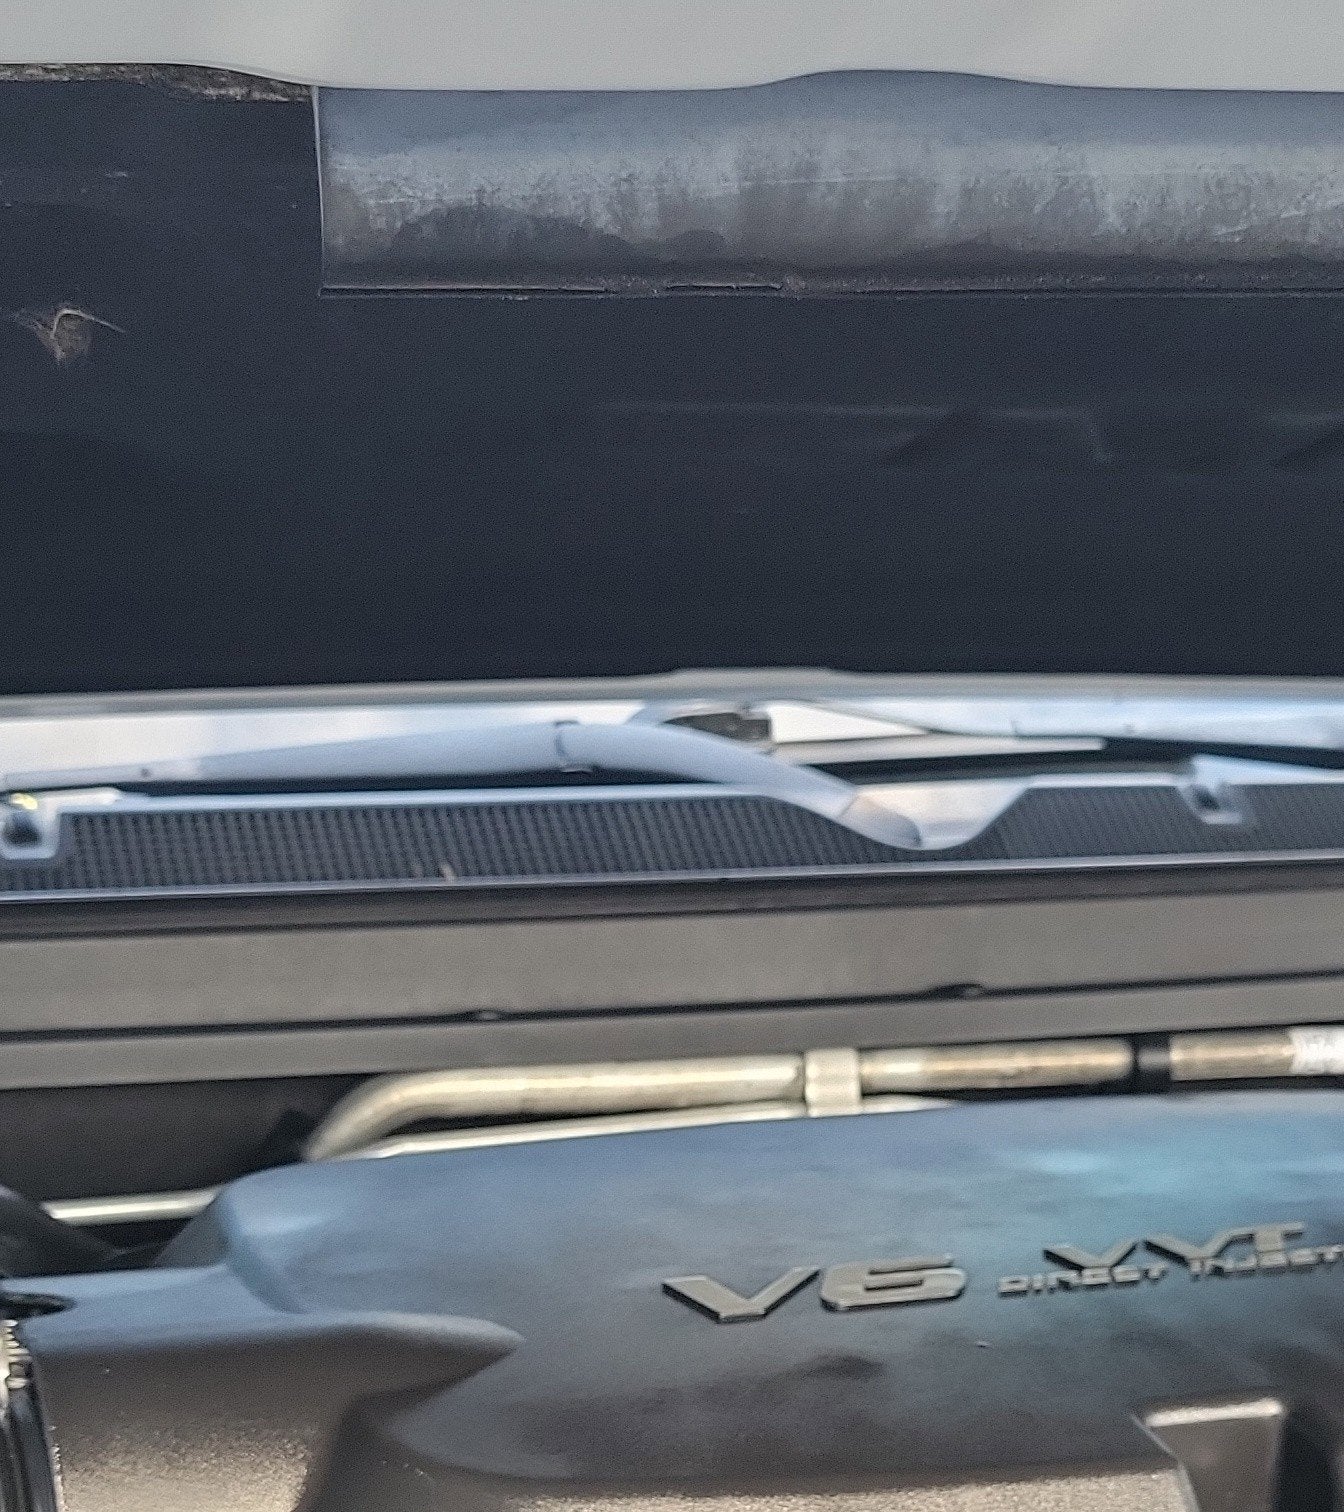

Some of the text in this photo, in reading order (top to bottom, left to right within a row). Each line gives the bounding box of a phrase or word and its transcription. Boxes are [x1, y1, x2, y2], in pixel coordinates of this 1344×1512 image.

[661, 1221, 1305, 1323] V6 VVT
[997, 1261, 1171, 1297] DIRECT
